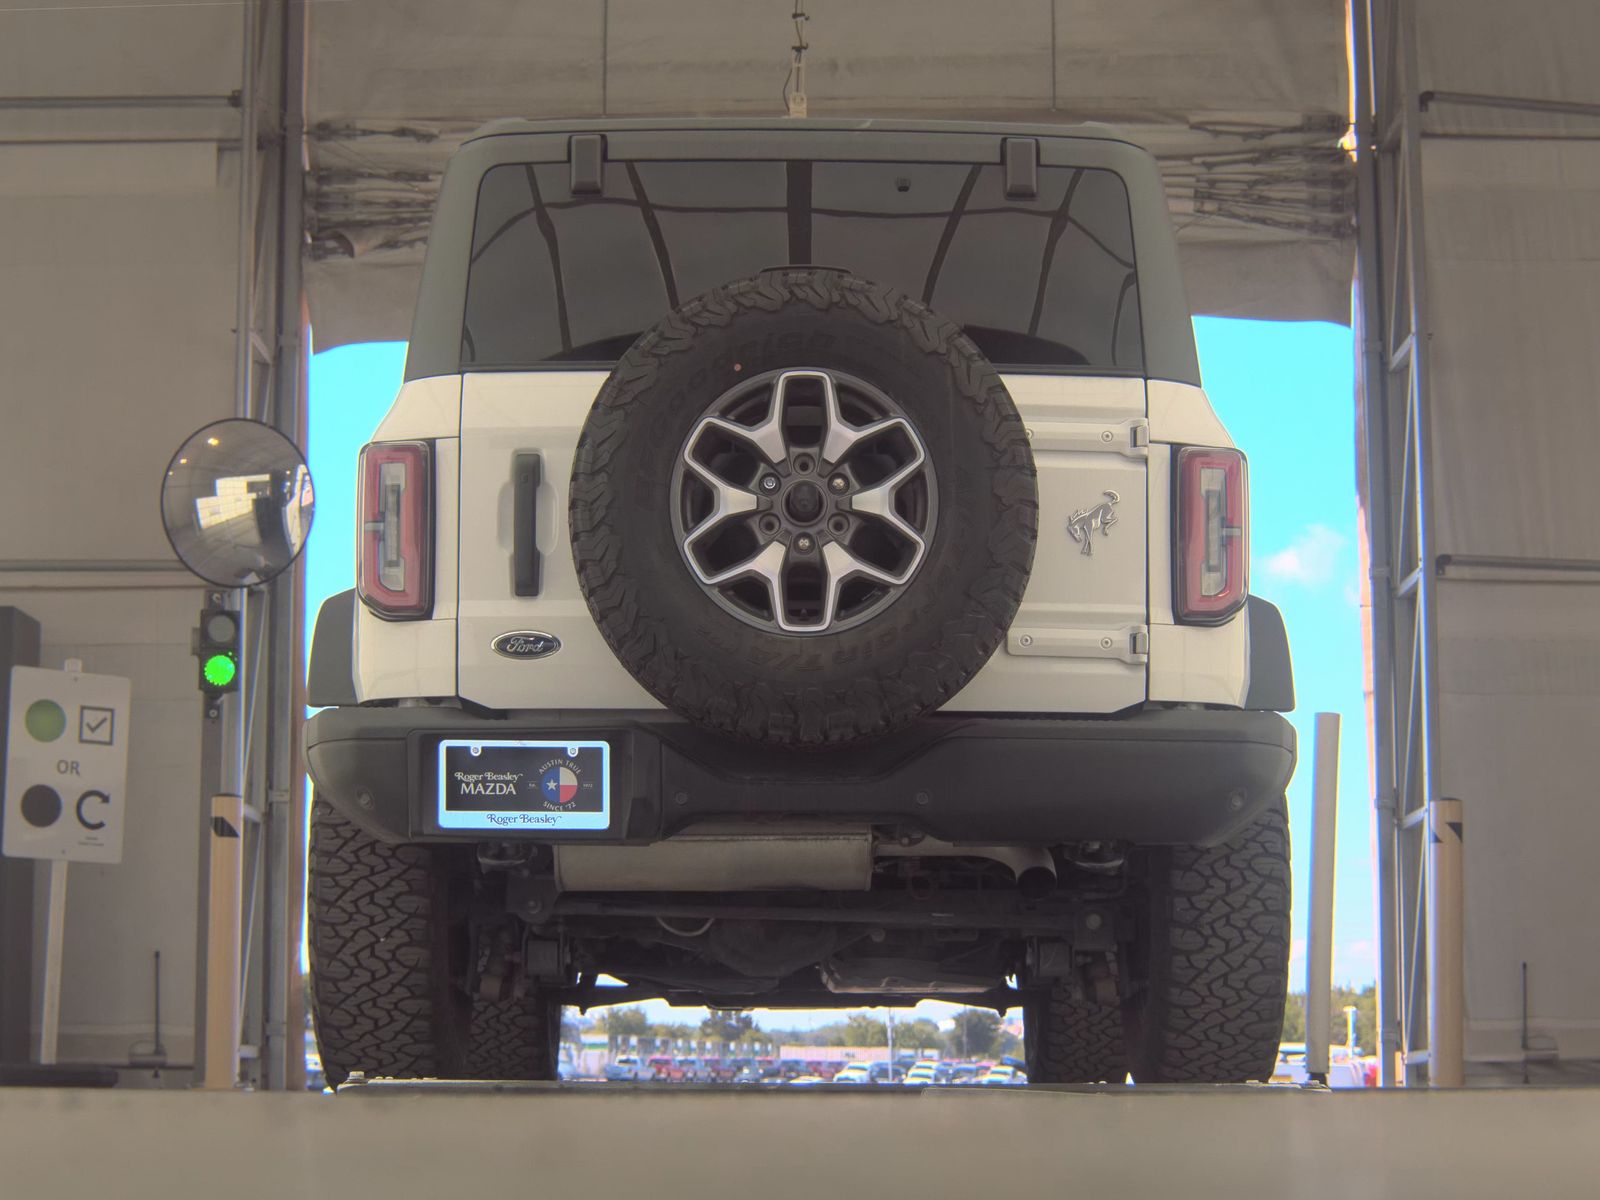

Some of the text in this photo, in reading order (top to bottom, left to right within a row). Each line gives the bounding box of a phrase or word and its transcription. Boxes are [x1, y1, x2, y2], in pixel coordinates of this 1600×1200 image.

[506, 636, 544, 652] Ford
[56, 759, 81, 776] OR
[539, 759, 582, 775] AUSTIN TRUE
[454, 771, 524, 783] Roger Beasley
[460, 783, 517, 795] MAZDA
[542, 800, 563, 812] SINCE
[486, 813, 562, 826] Roger Beasley
